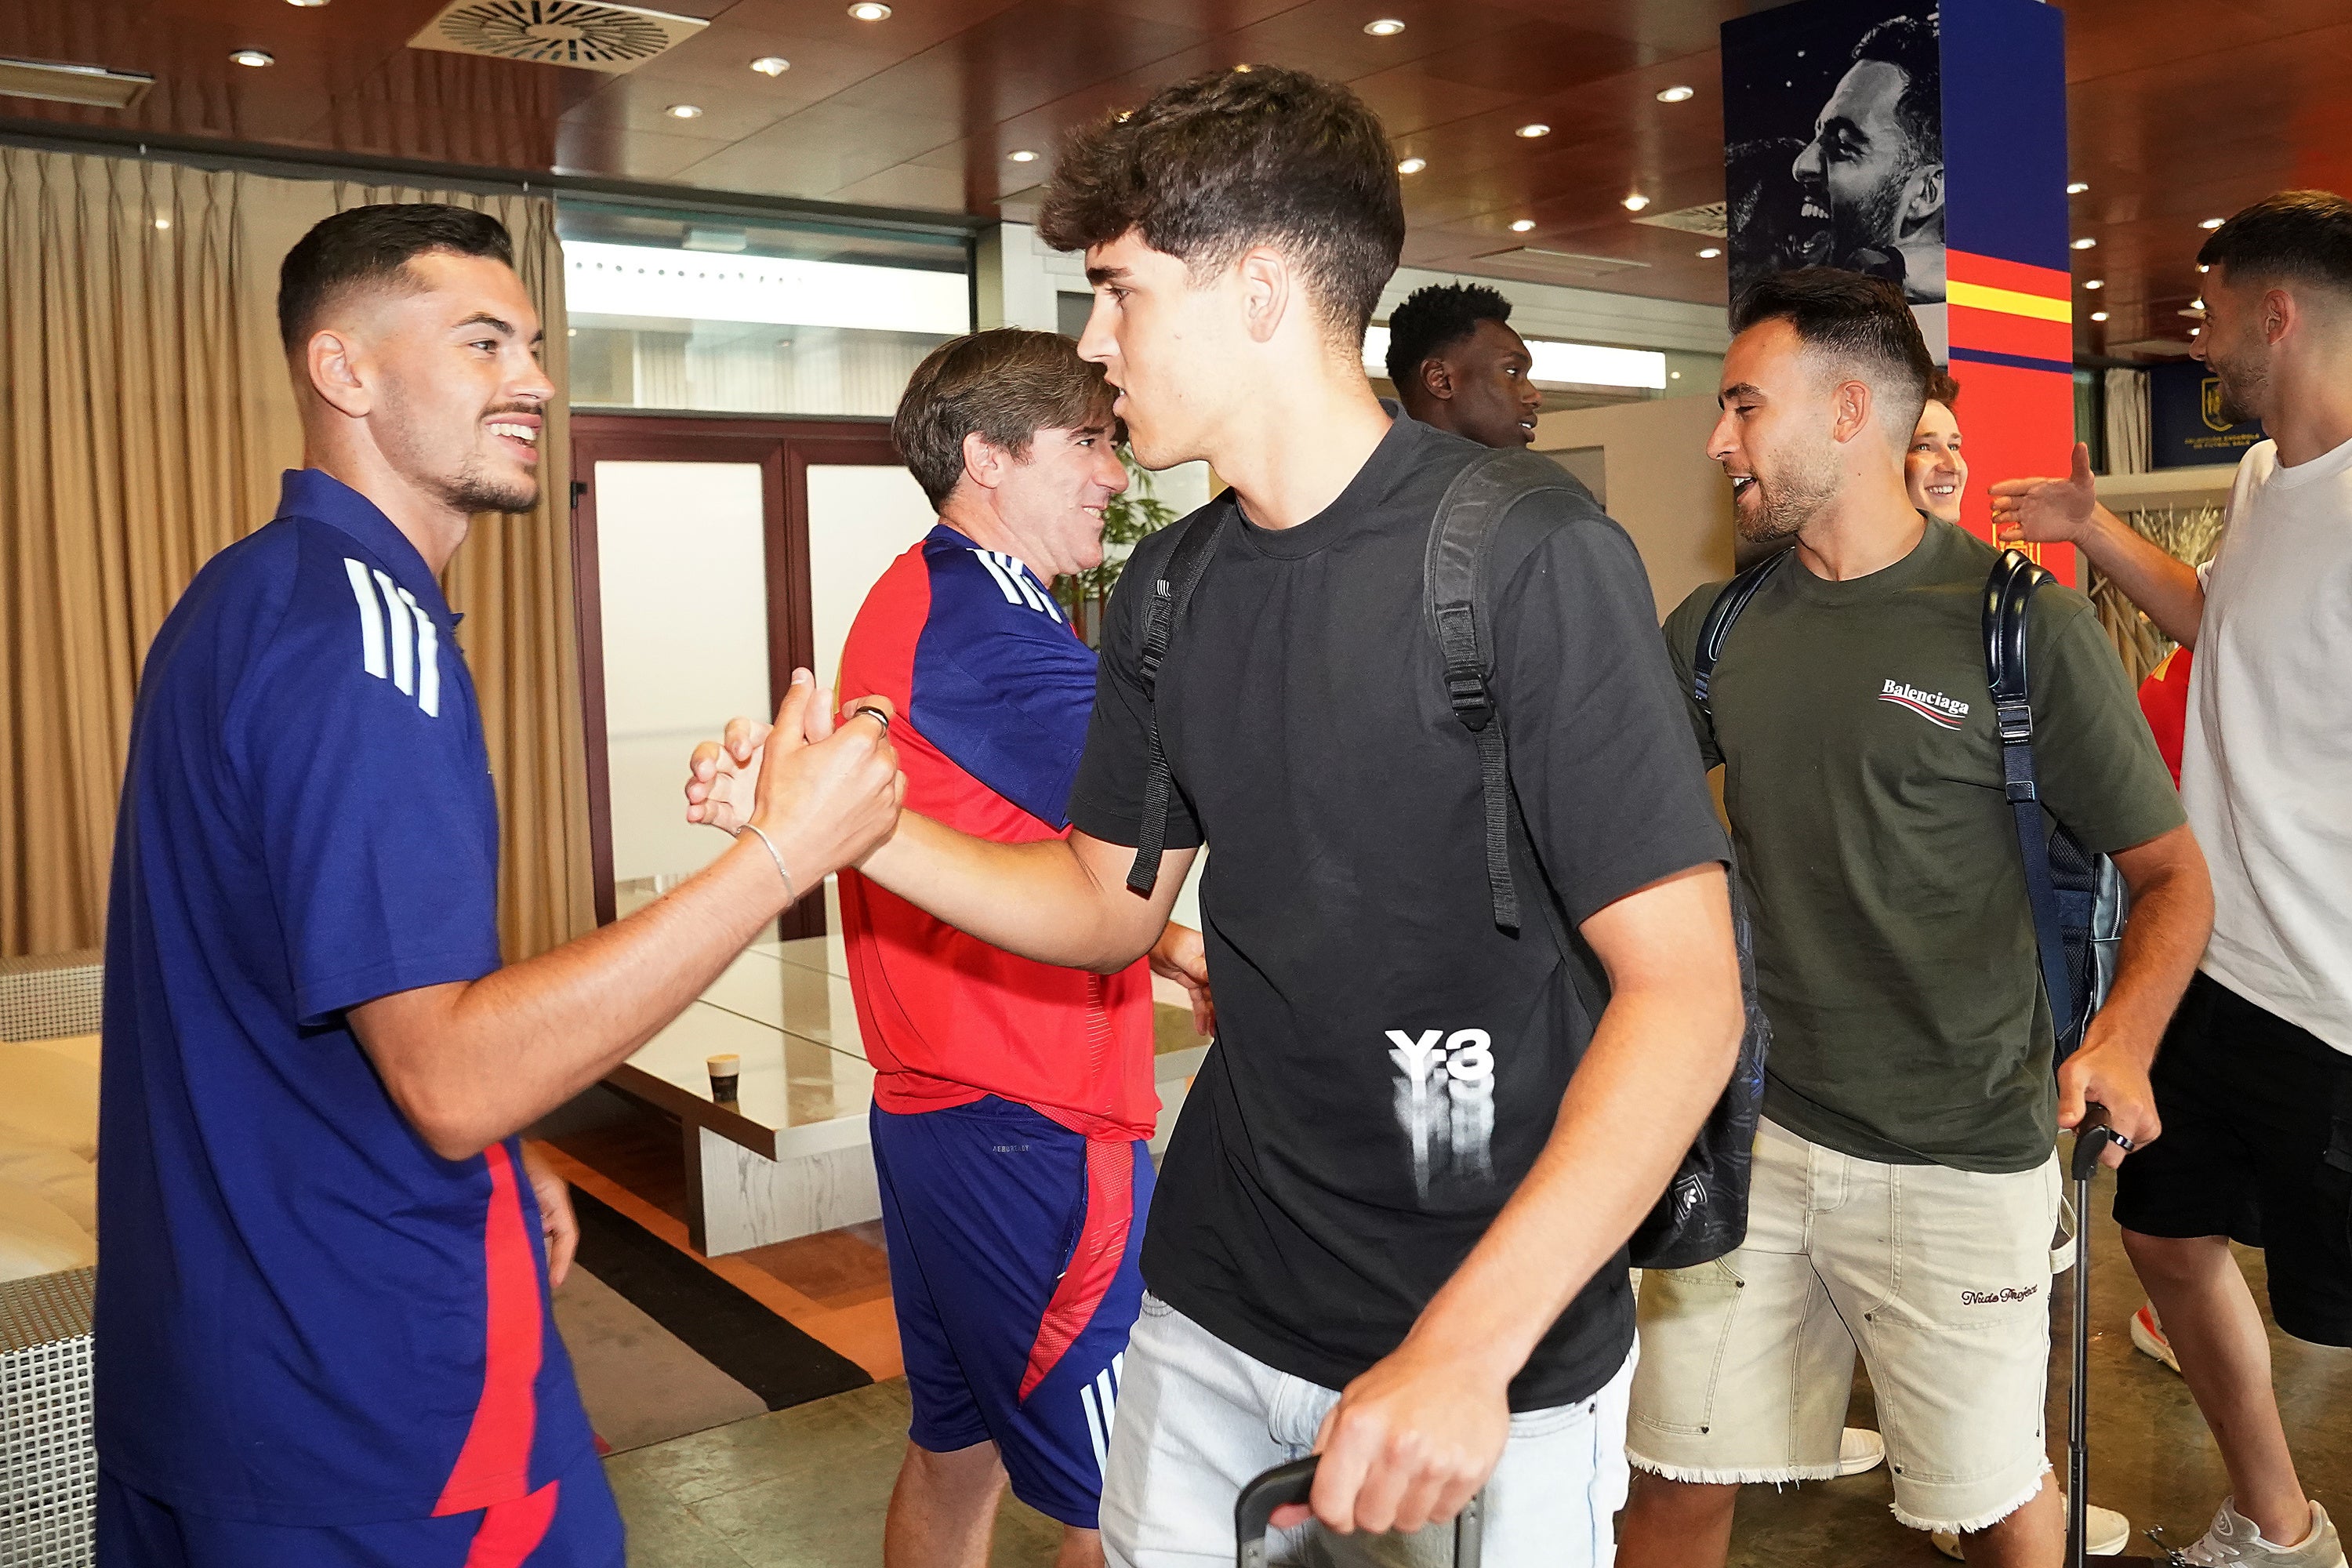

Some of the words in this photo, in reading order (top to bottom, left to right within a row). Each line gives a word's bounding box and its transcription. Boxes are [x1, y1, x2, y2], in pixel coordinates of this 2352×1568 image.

[1882, 679, 1969, 715] Balenciaga
[1385, 1028, 1494, 1081] Y-3
[1962, 1291, 1999, 1305] Nude
